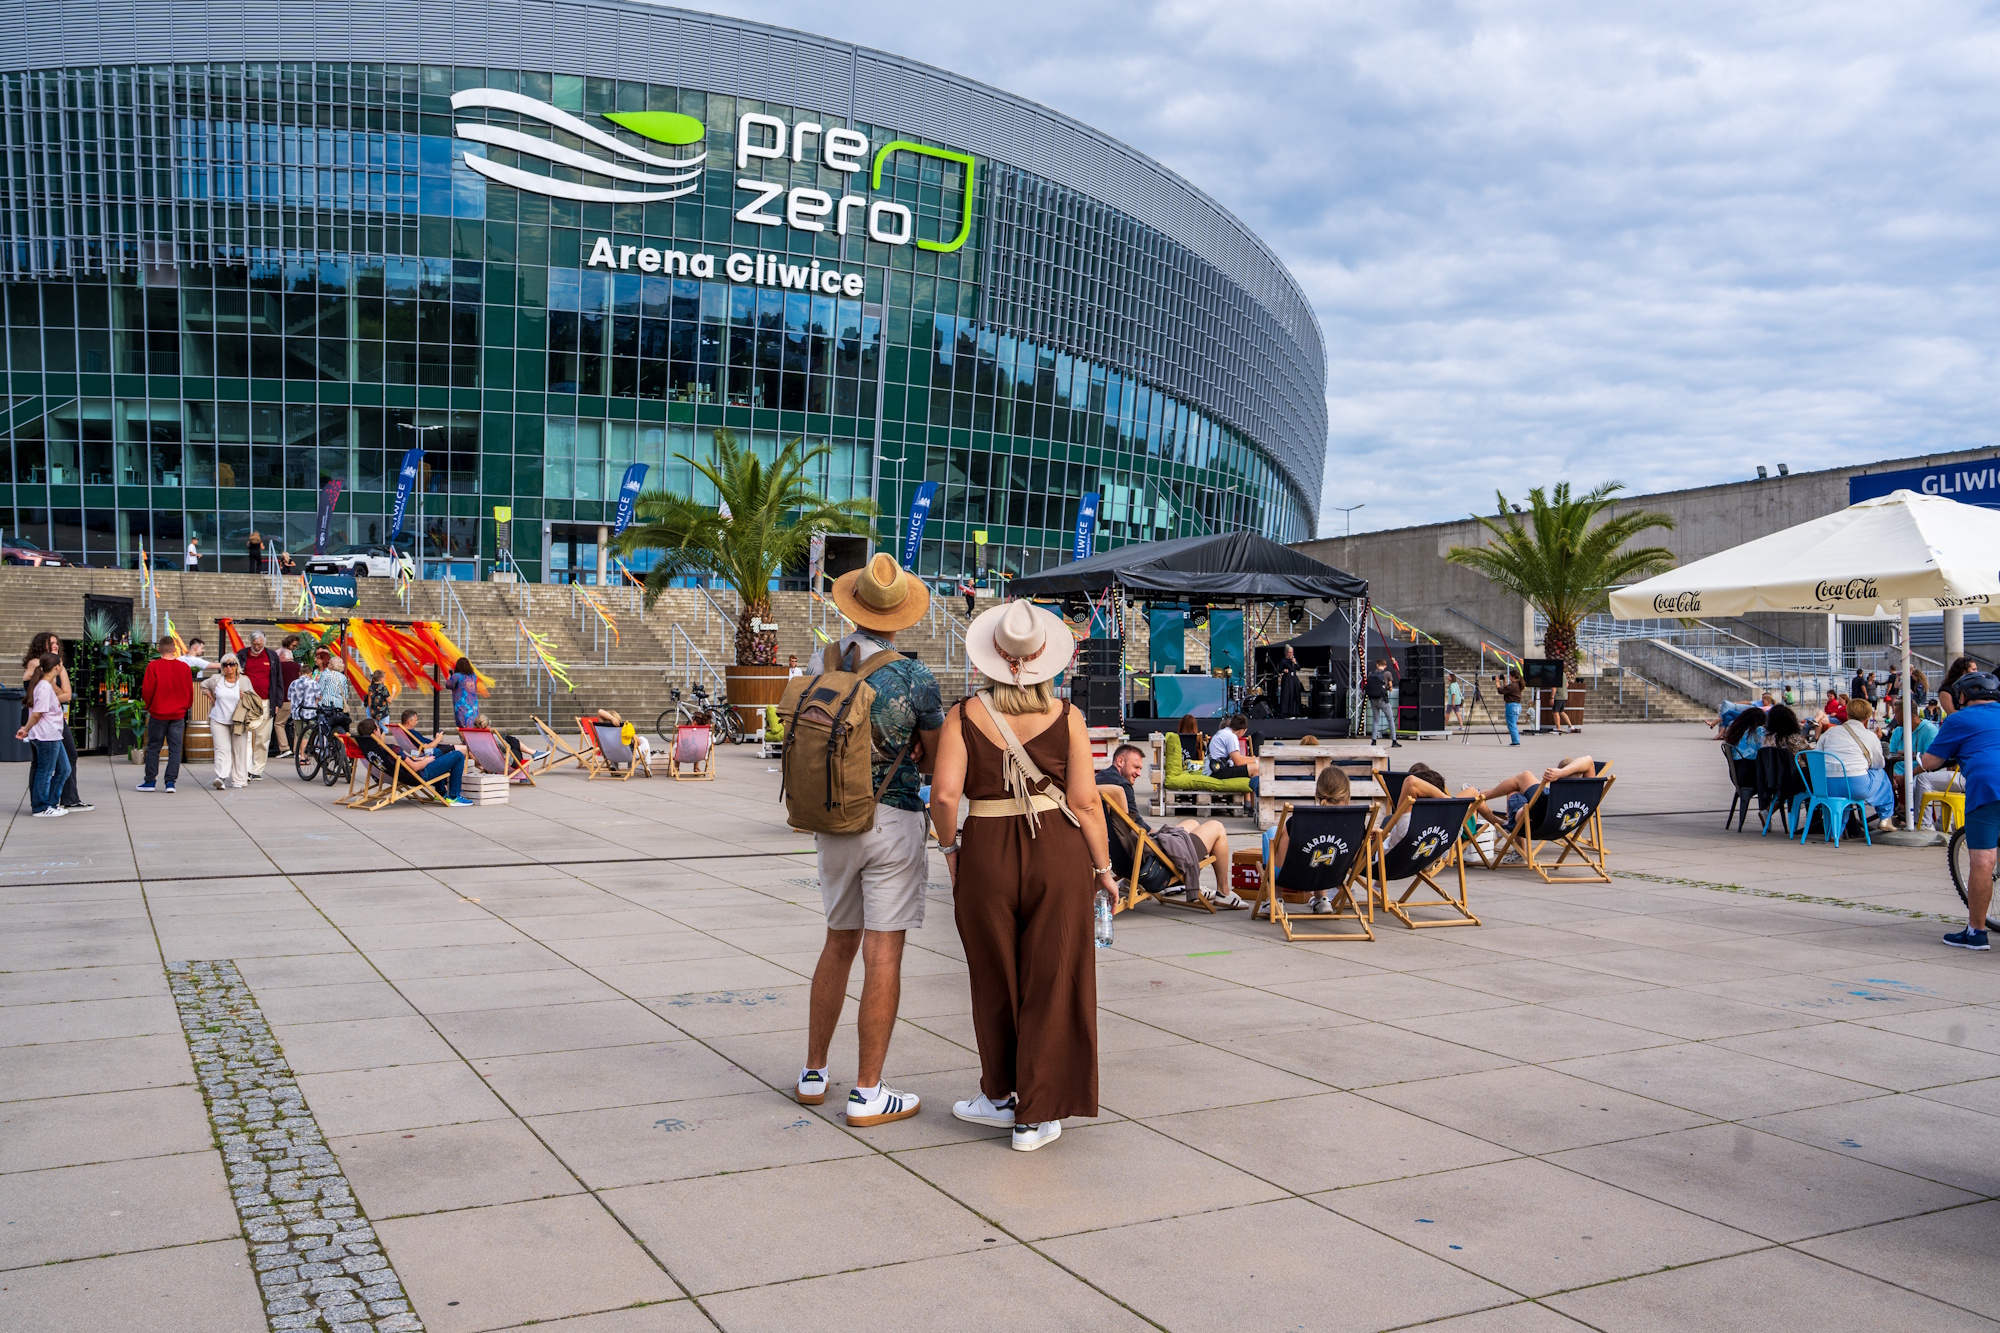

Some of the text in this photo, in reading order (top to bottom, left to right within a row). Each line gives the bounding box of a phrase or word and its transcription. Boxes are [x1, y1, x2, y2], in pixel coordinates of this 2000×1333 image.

[738, 112, 868, 173] pre
[735, 178, 912, 245] zero
[587, 236, 864, 297] Arena Gliwice
[1921, 468, 2000, 495] GLIWI
[905, 512, 922, 559] GLIWICE
[1076, 521, 1088, 562] LIWICE
[312, 585, 347, 596] TOALETY
[1653, 591, 1702, 613] Coca-Cola
[1815, 577, 1880, 602] Coca-Cola
[1301, 834, 1349, 855] HARDMADE
[1411, 825, 1449, 846] HARDMADE
